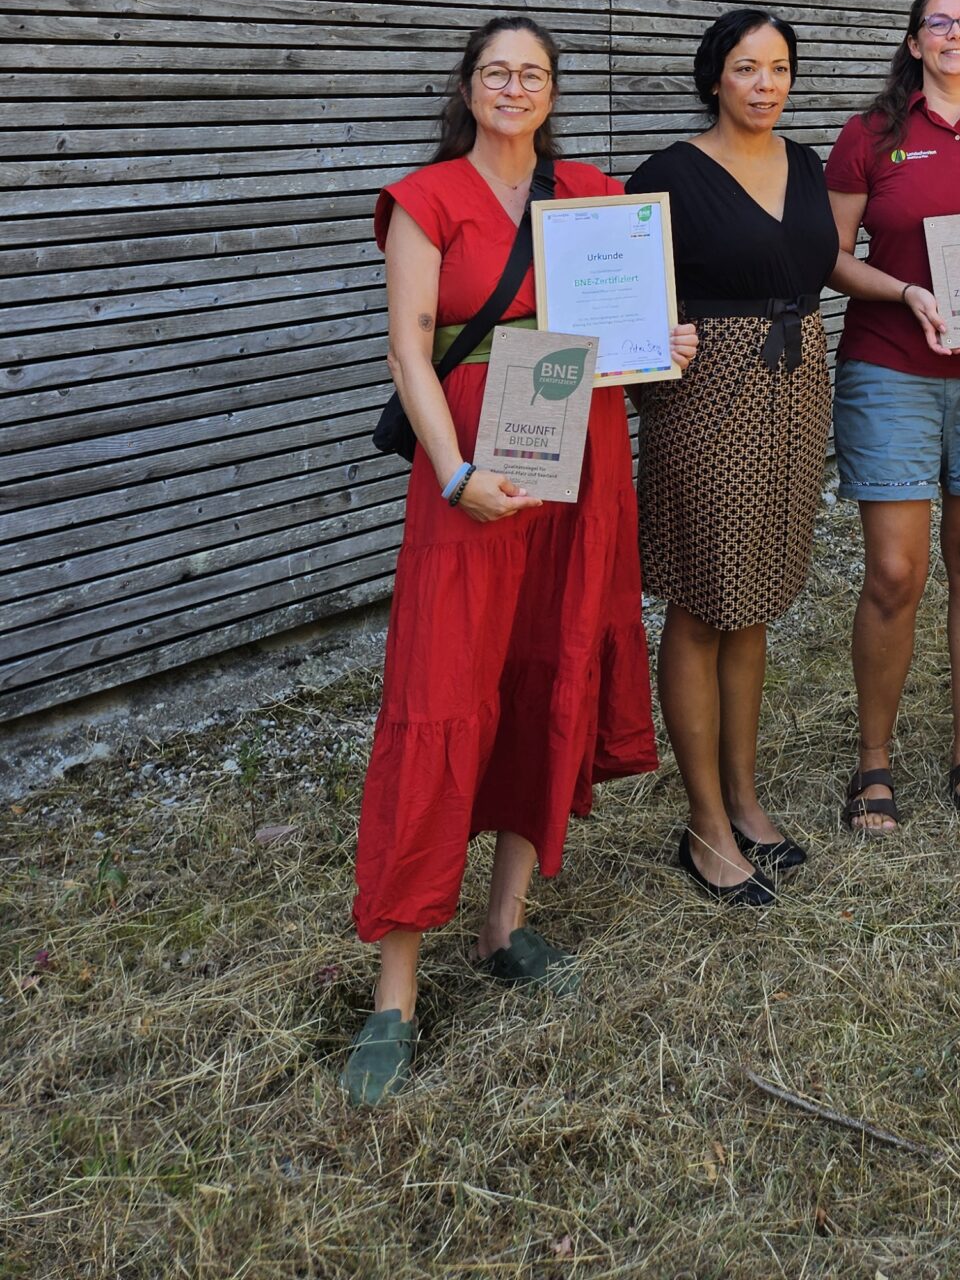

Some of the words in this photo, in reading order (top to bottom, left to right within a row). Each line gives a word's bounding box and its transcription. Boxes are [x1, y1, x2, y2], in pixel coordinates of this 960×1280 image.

[587, 251, 624, 262] Urkunde
[574, 274, 639, 287] BNE-Zertifiziert
[541, 362, 579, 380] BNE
[504, 422, 557, 436] ZUKUNFT
[509, 435, 549, 448] BILDEN
